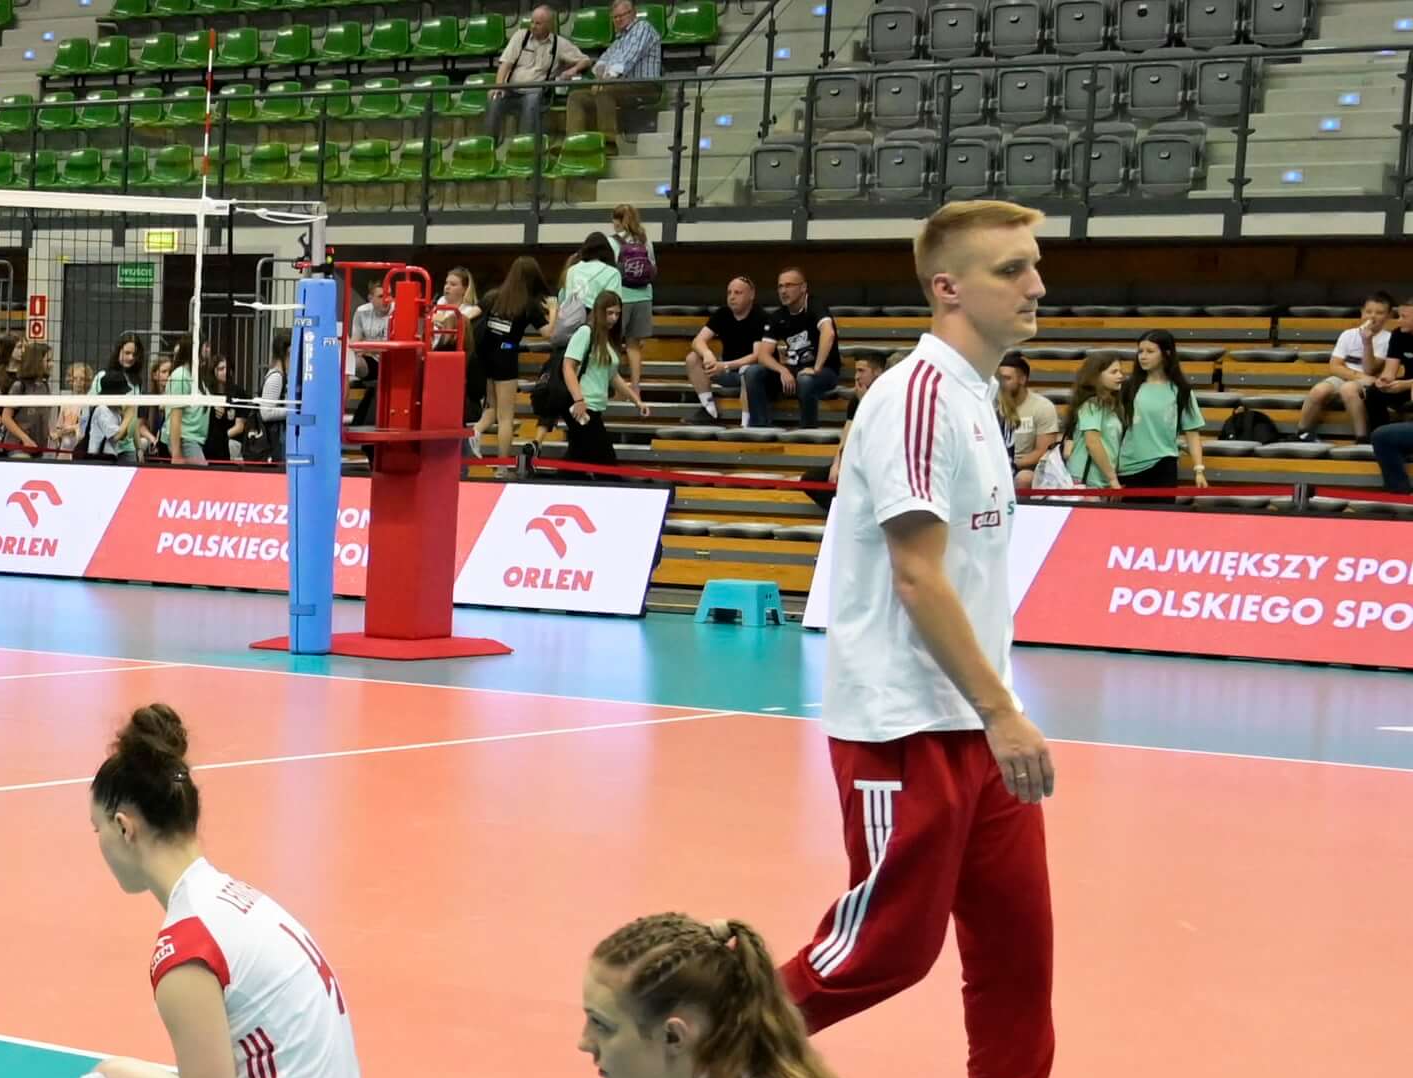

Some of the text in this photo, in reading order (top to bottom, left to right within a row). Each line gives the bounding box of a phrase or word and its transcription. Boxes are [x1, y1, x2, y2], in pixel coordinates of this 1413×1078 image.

[157, 498, 289, 527] NAJWIĘKSZ
[156, 532, 290, 562] POLSKIEG
[503, 565, 594, 592] ORLEN
[1107, 545, 1413, 586] NAJWIĘKSZY SPO
[1108, 586, 1323, 626] POLSKIEGO
